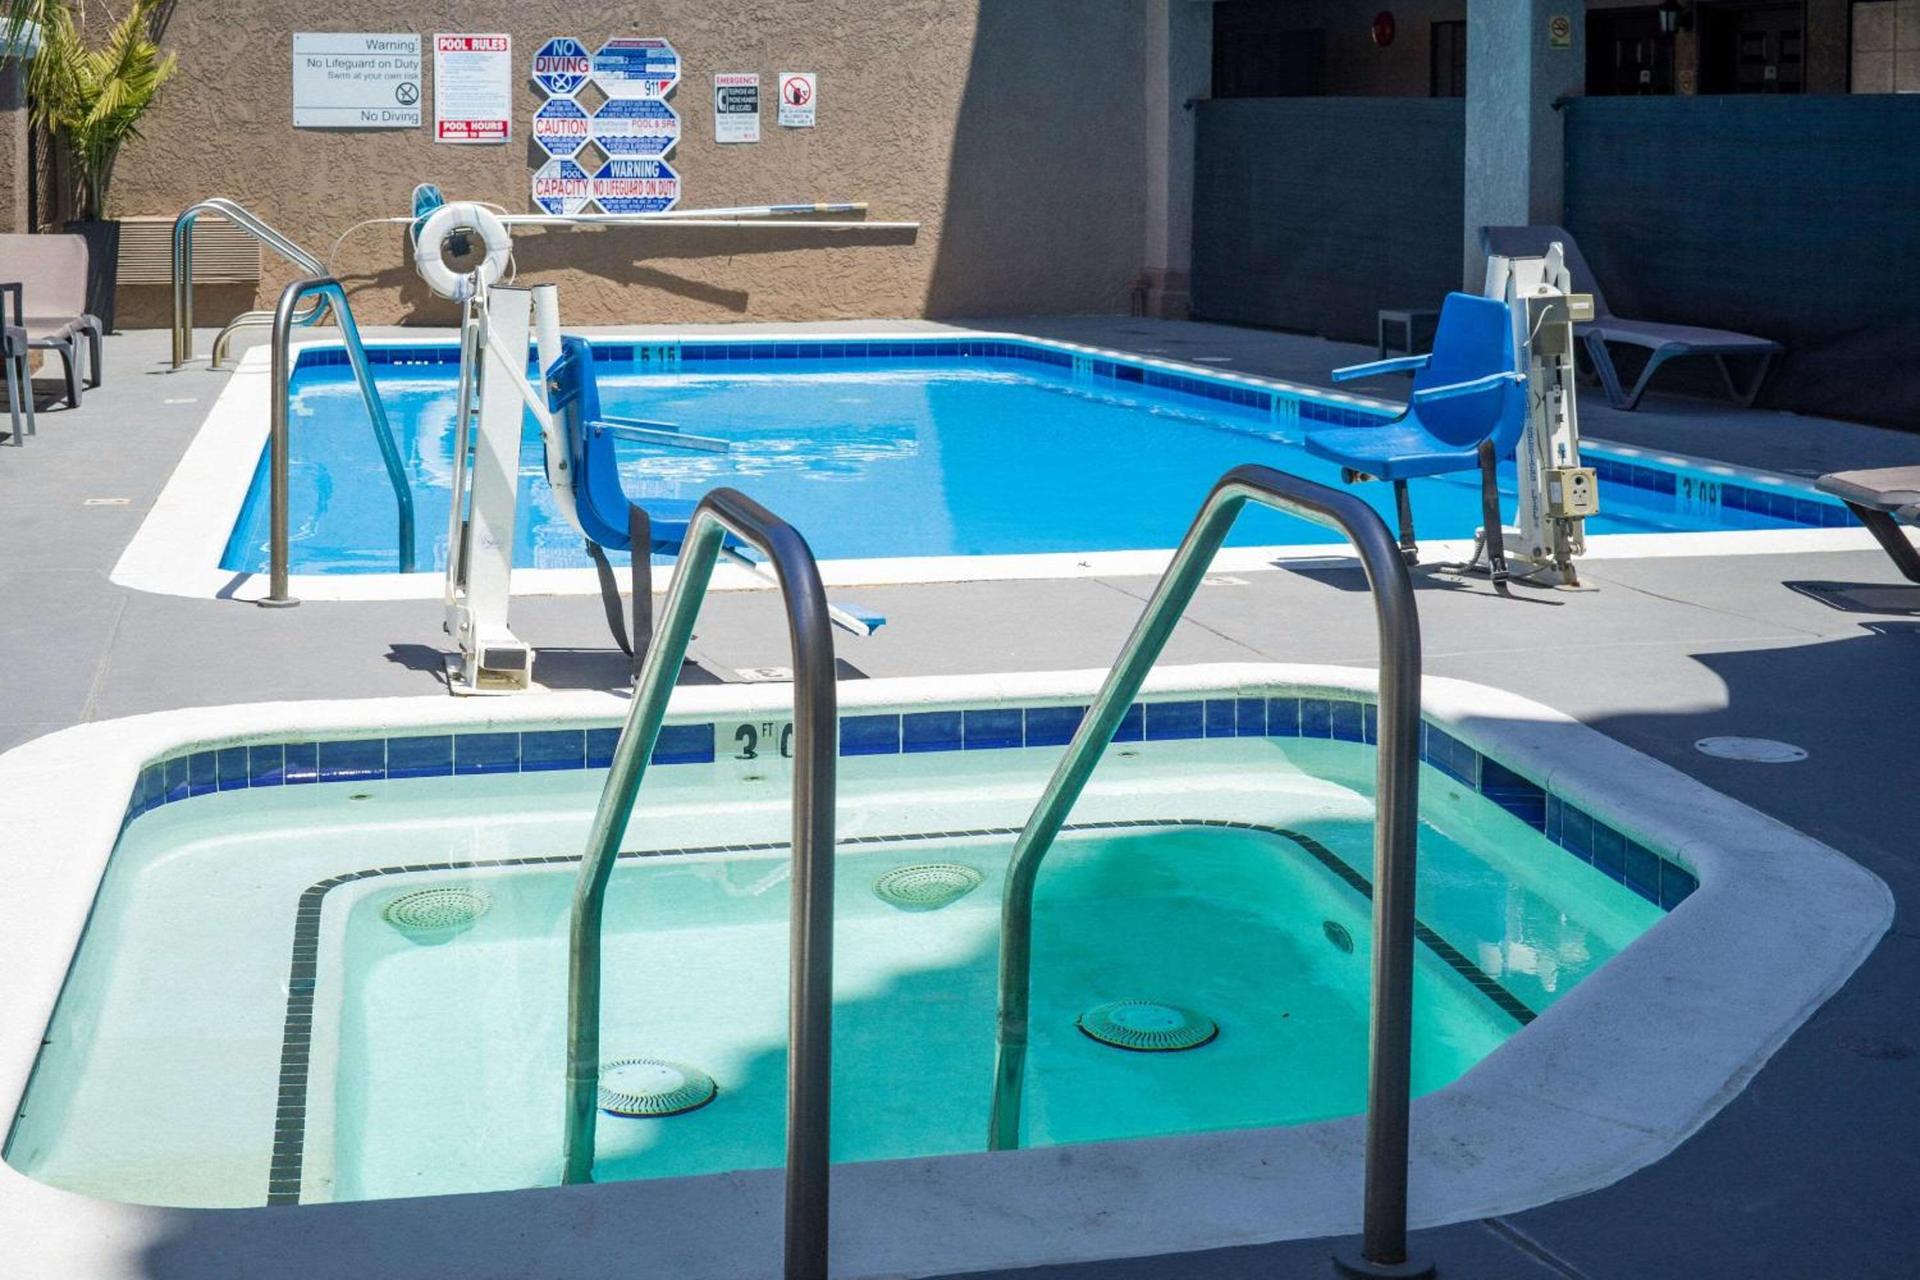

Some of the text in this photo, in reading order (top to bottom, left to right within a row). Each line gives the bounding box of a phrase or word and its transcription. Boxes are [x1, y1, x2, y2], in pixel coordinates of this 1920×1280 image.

[365, 39, 416, 53] Warning
[439, 38, 506, 51] POOL RULES
[553, 40, 575, 56] NO
[306, 58, 420, 71] No Lifeguard on Duty
[535, 56, 589, 73] DIVING
[644, 80, 660, 96] 911
[360, 110, 420, 125] No Diving
[443, 121, 504, 131] POOL HOURS
[535, 119, 588, 135] CAUTION
[561, 170, 583, 179] POOL
[610, 160, 660, 178] WARNING
[535, 179, 589, 196] CAPACITY
[593, 180, 677, 196] NO LIFEGUARD ON DUTY
[762, 722, 774, 738] FT
